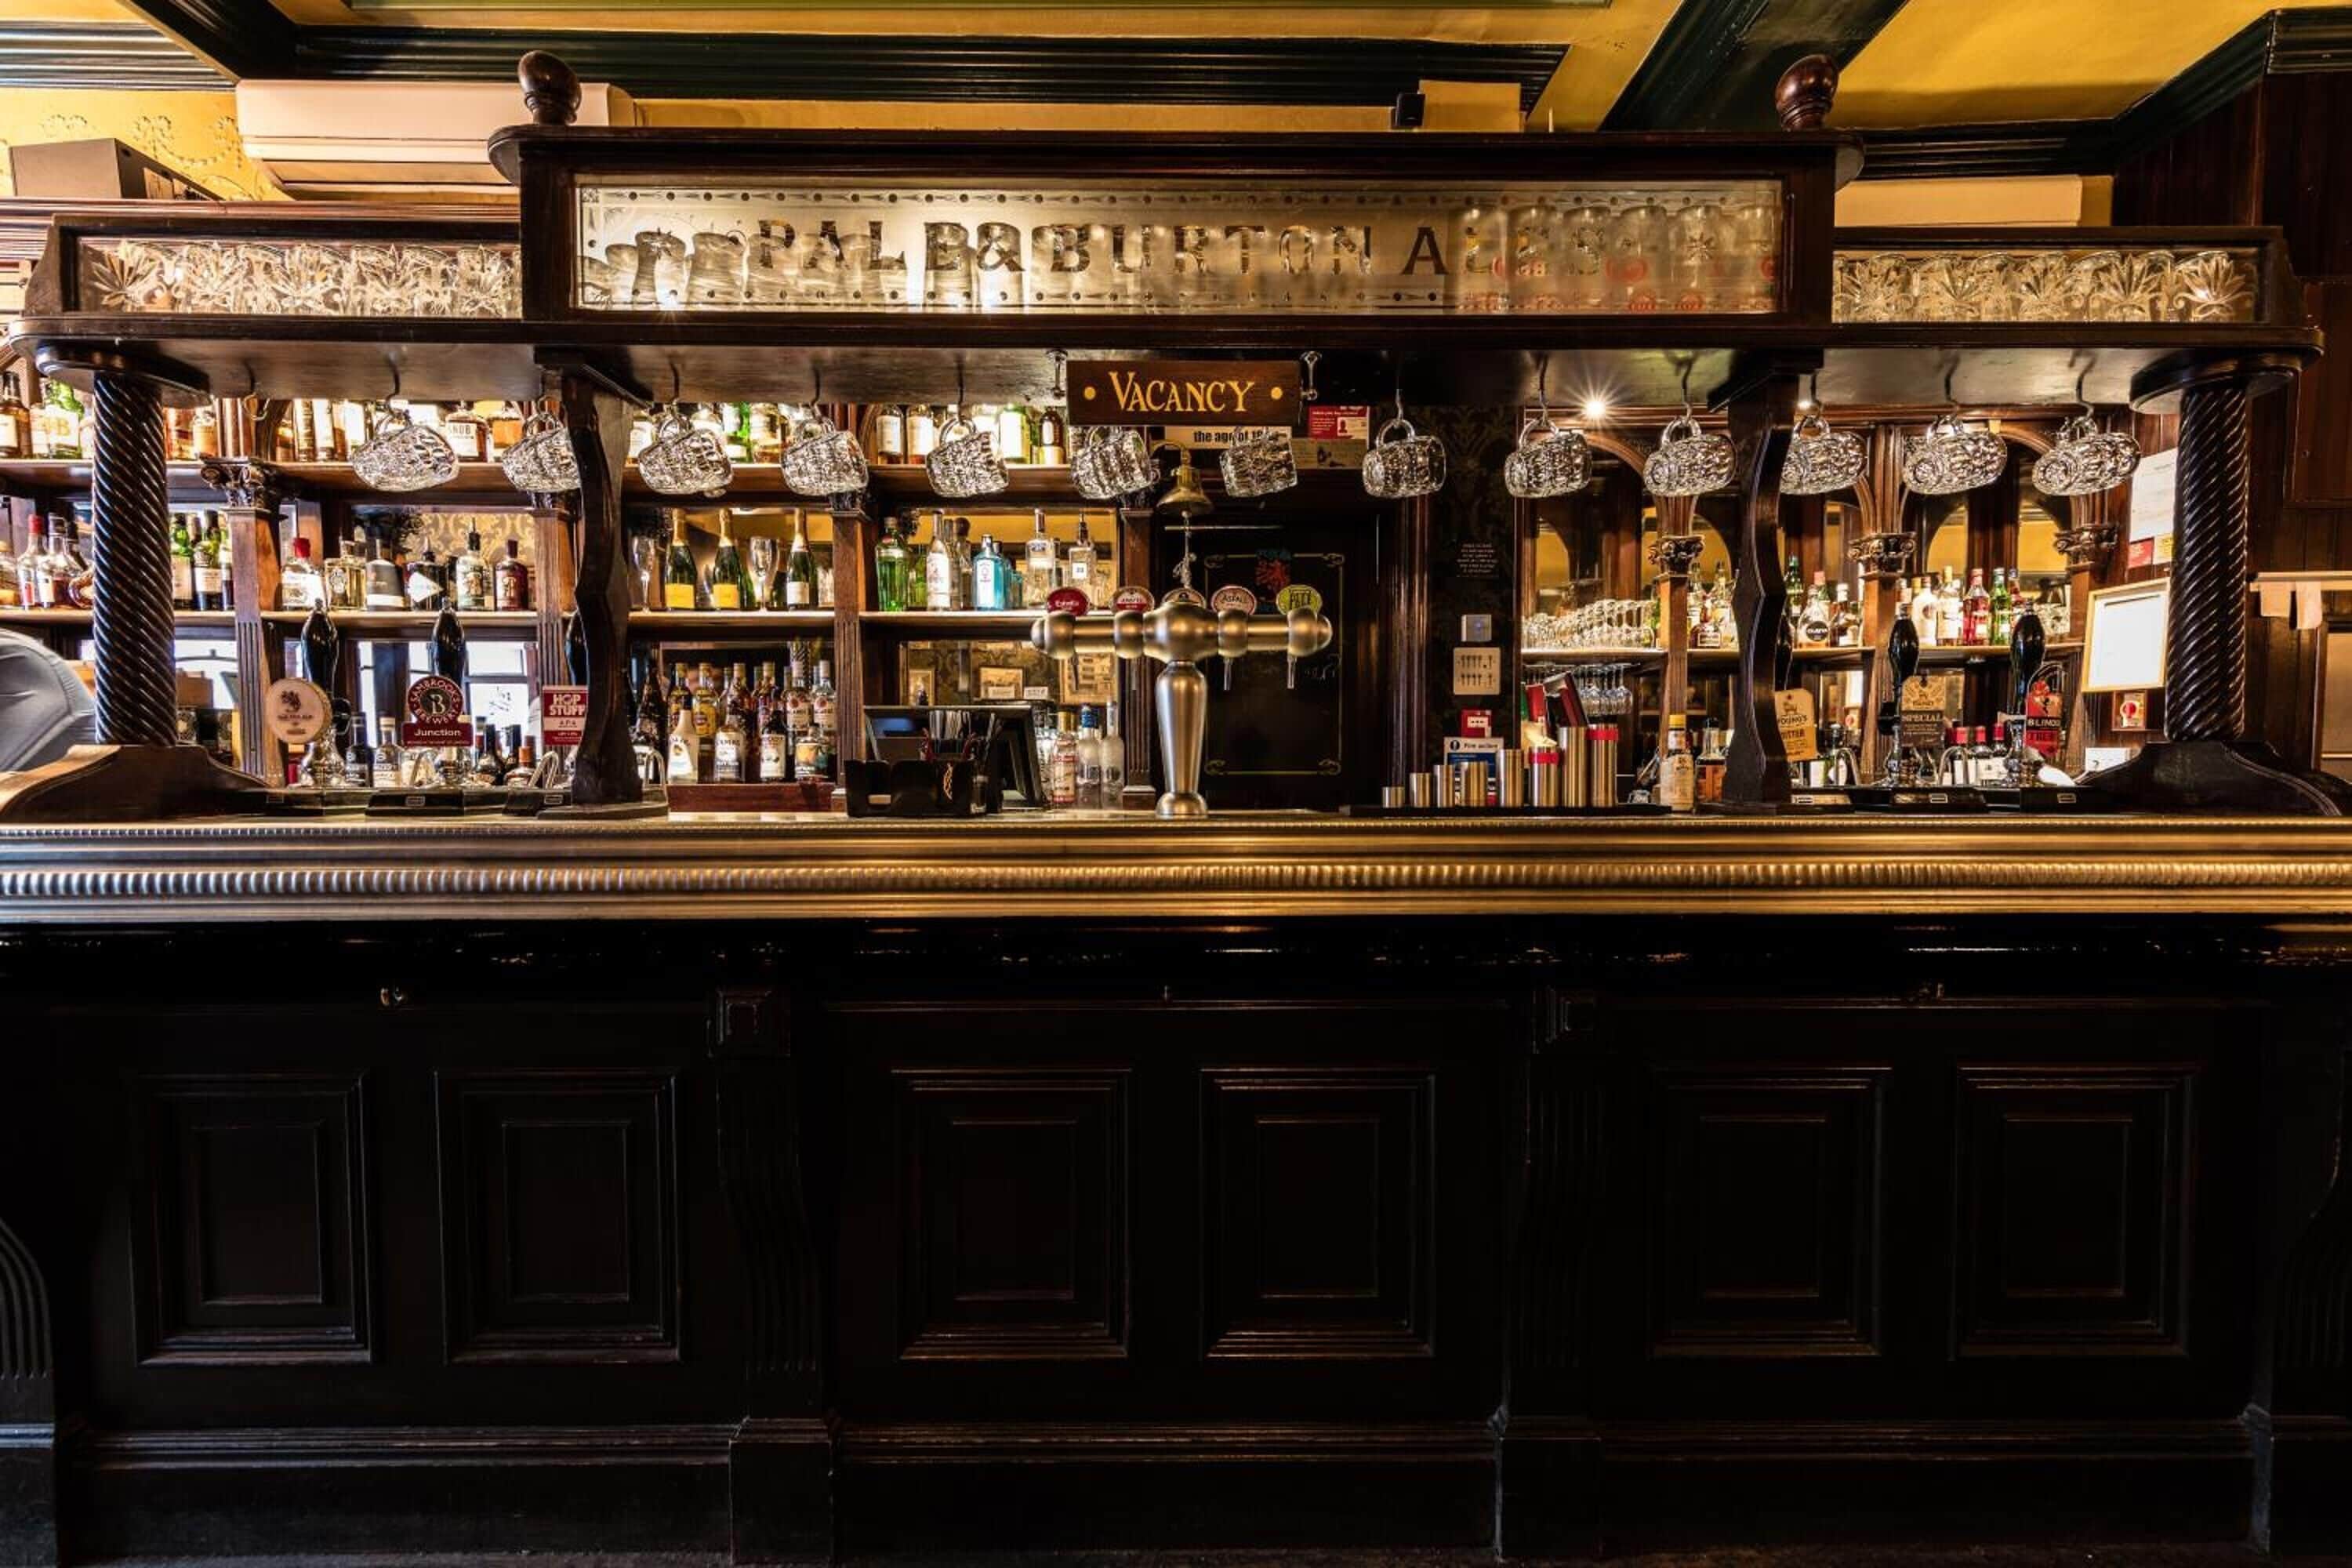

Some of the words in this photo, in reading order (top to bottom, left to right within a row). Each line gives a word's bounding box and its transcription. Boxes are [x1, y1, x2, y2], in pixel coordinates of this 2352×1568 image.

[1050, 223, 1373, 275] BURTON
[1108, 370, 1255, 413] VACANCY
[1193, 430, 1212, 442] the
[553, 694, 581, 706] HOP
[549, 704, 586, 716] STUFF
